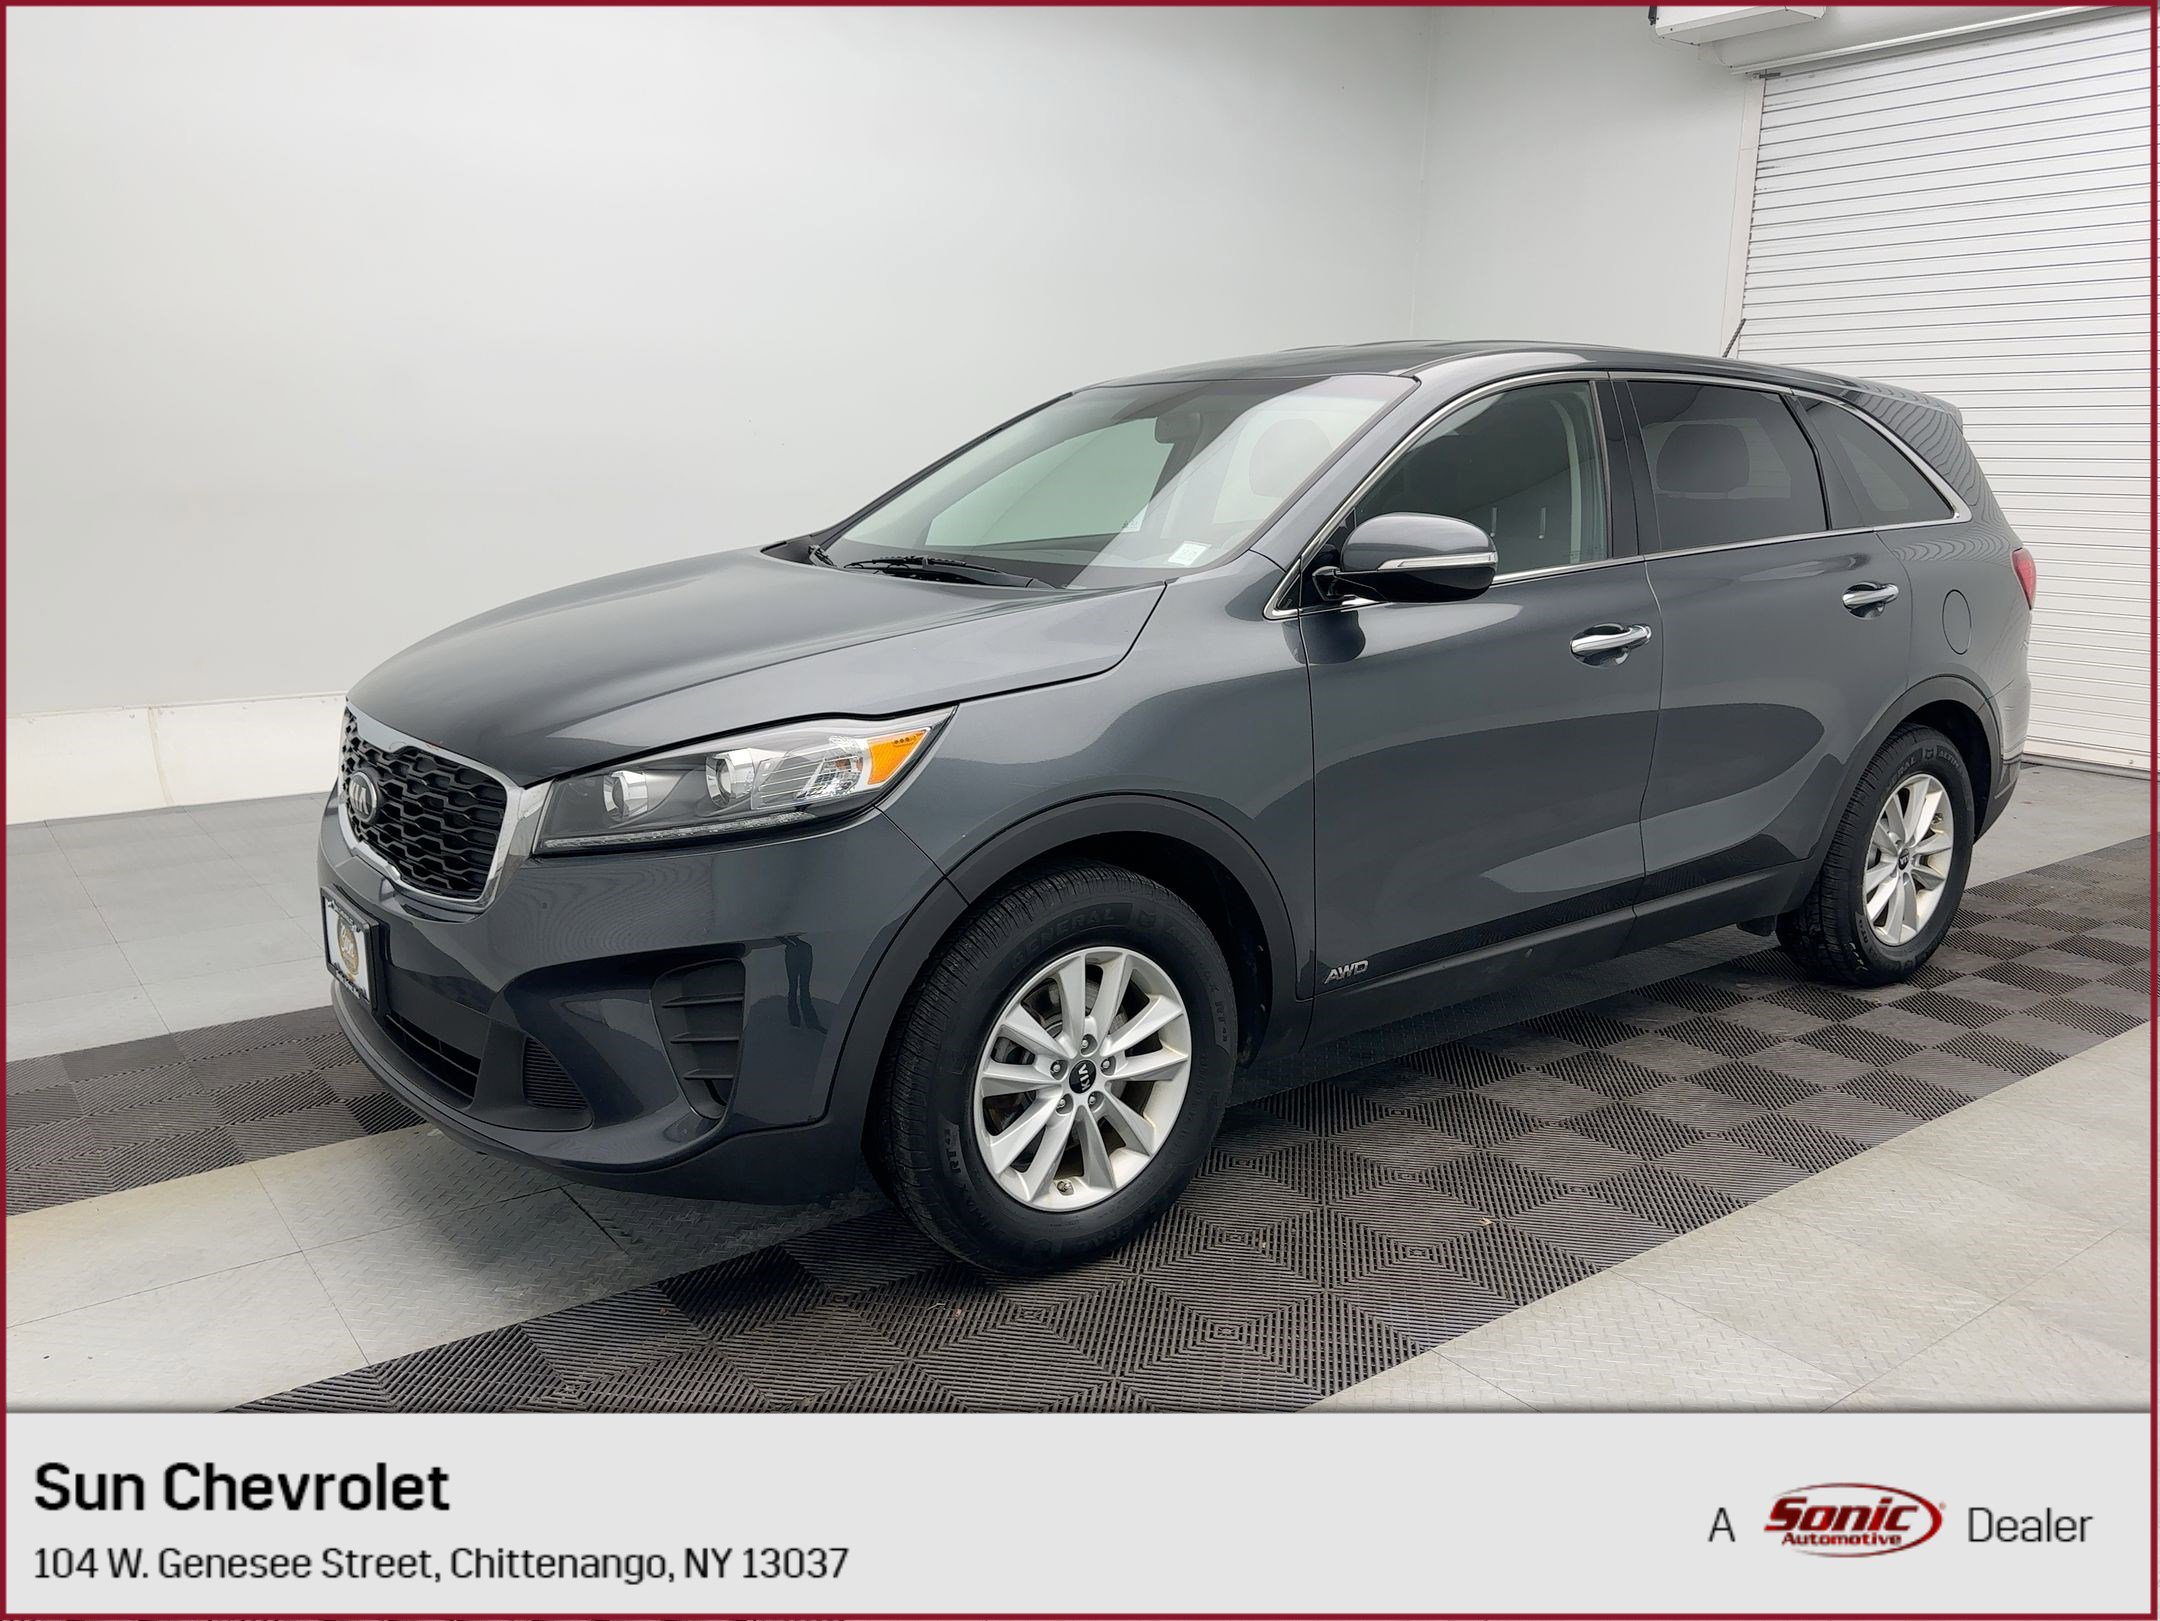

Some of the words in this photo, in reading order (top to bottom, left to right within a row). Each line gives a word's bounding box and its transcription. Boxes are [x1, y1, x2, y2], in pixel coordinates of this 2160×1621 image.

[349, 780, 369, 815] KIA
[1324, 960, 1369, 984] AWD
[1078, 1063, 1091, 1091] KIA
